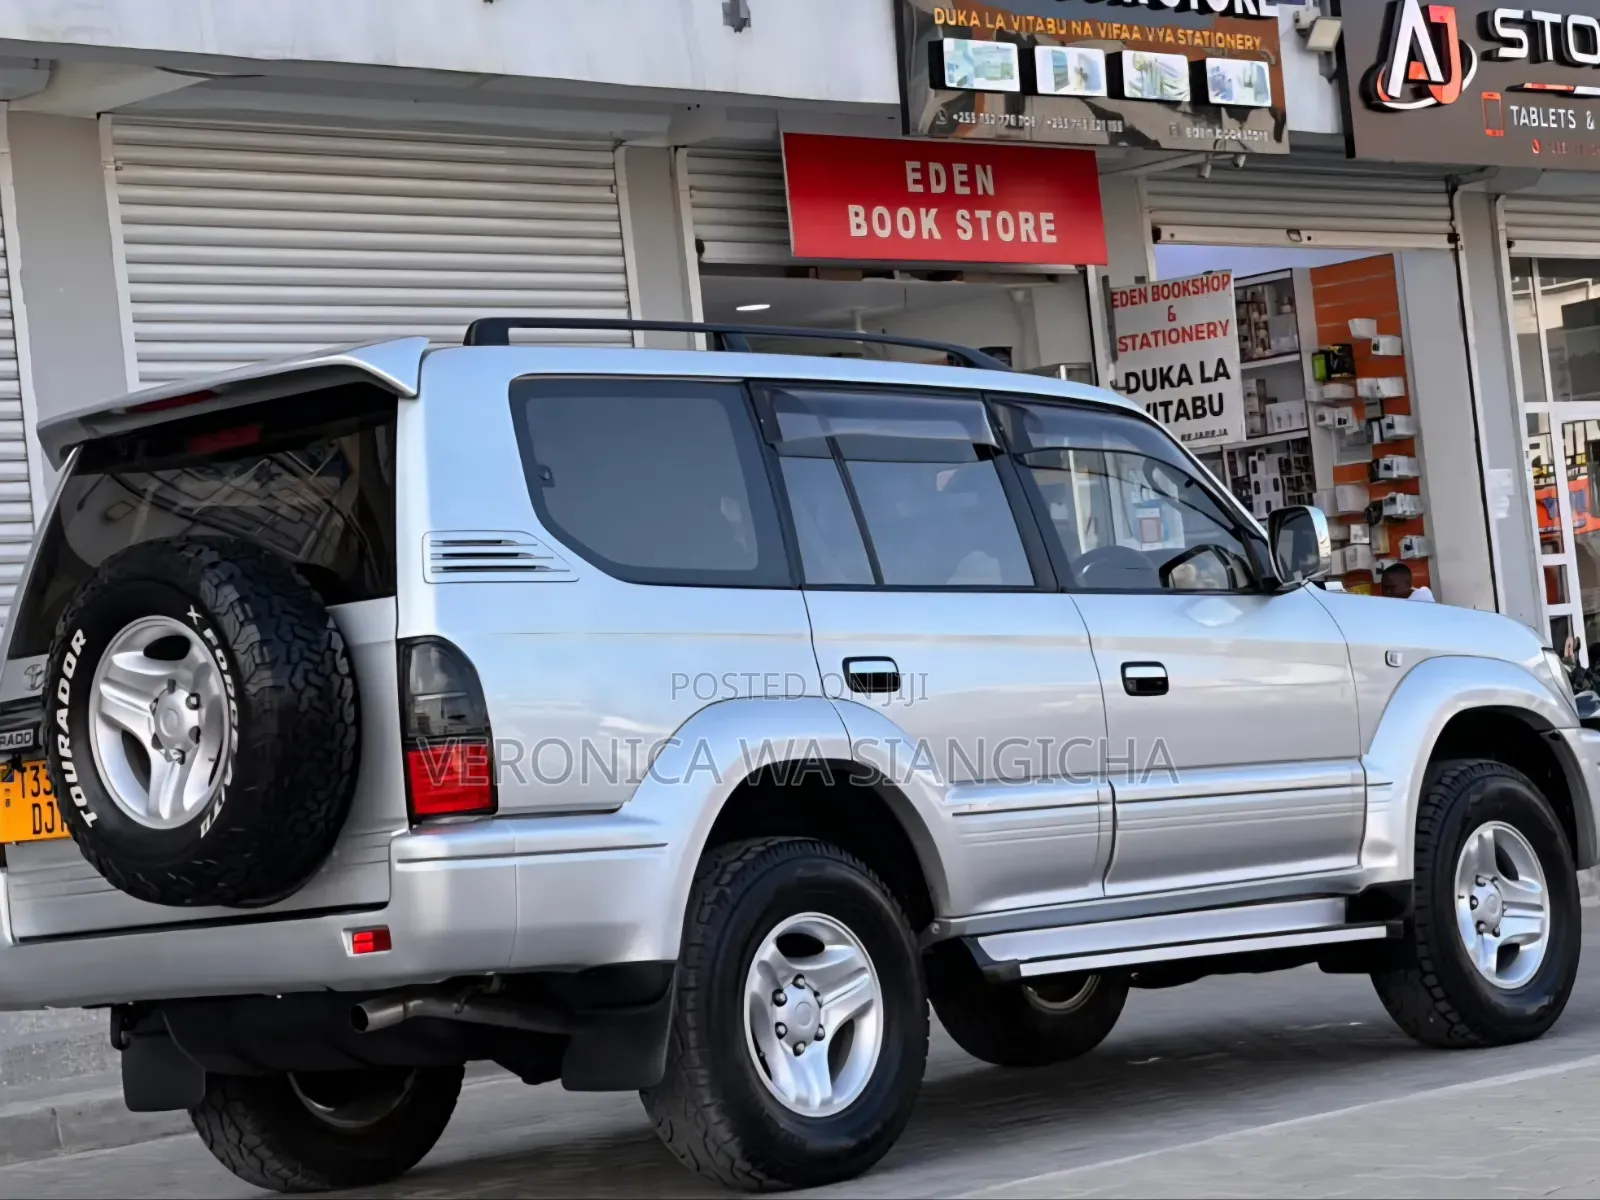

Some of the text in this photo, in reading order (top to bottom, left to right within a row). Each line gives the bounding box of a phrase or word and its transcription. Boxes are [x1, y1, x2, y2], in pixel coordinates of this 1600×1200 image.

[933, 7, 1262, 50] DUKA LA VITABU NA VIFAA VYA STATIONERY
[1494, 8, 1600, 65] STO
[1387, 0, 1462, 104] AJ
[1510, 105, 1595, 129] TABLETS &
[905, 160, 995, 196] EDEN
[848, 204, 1058, 244] BOOK STORE
[1111, 273, 1231, 309] EDEN BOOKSHOP
[1167, 305, 1177, 322] &
[1118, 319, 1230, 353] STATIONERY
[1125, 357, 1231, 395] DUKA LA
[186, 604, 202, 625] X
[56, 628, 98, 828] TOURADOR
[20, 764, 54, 799] T33
